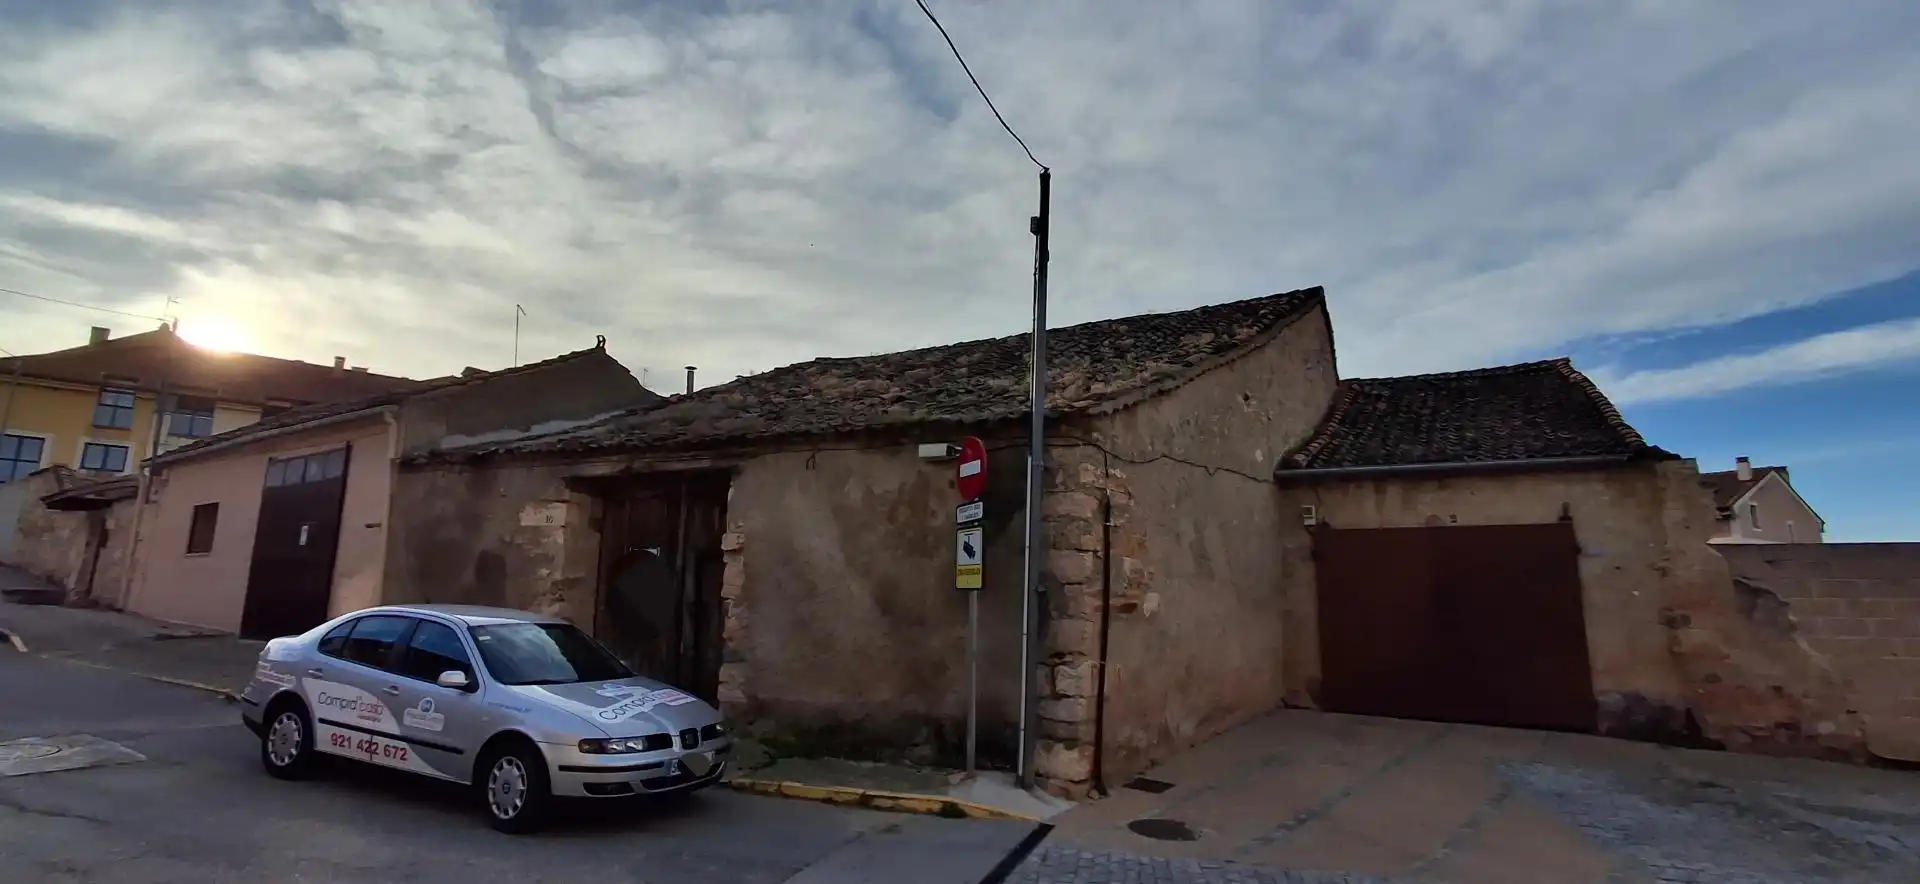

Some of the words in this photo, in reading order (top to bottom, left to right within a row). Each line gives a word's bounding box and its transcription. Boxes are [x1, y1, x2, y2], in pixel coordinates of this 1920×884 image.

[318, 691, 357, 713] Compra
[330, 732, 352, 749] 921
[356, 738, 380, 756] 422
[383, 744, 409, 762] 672
